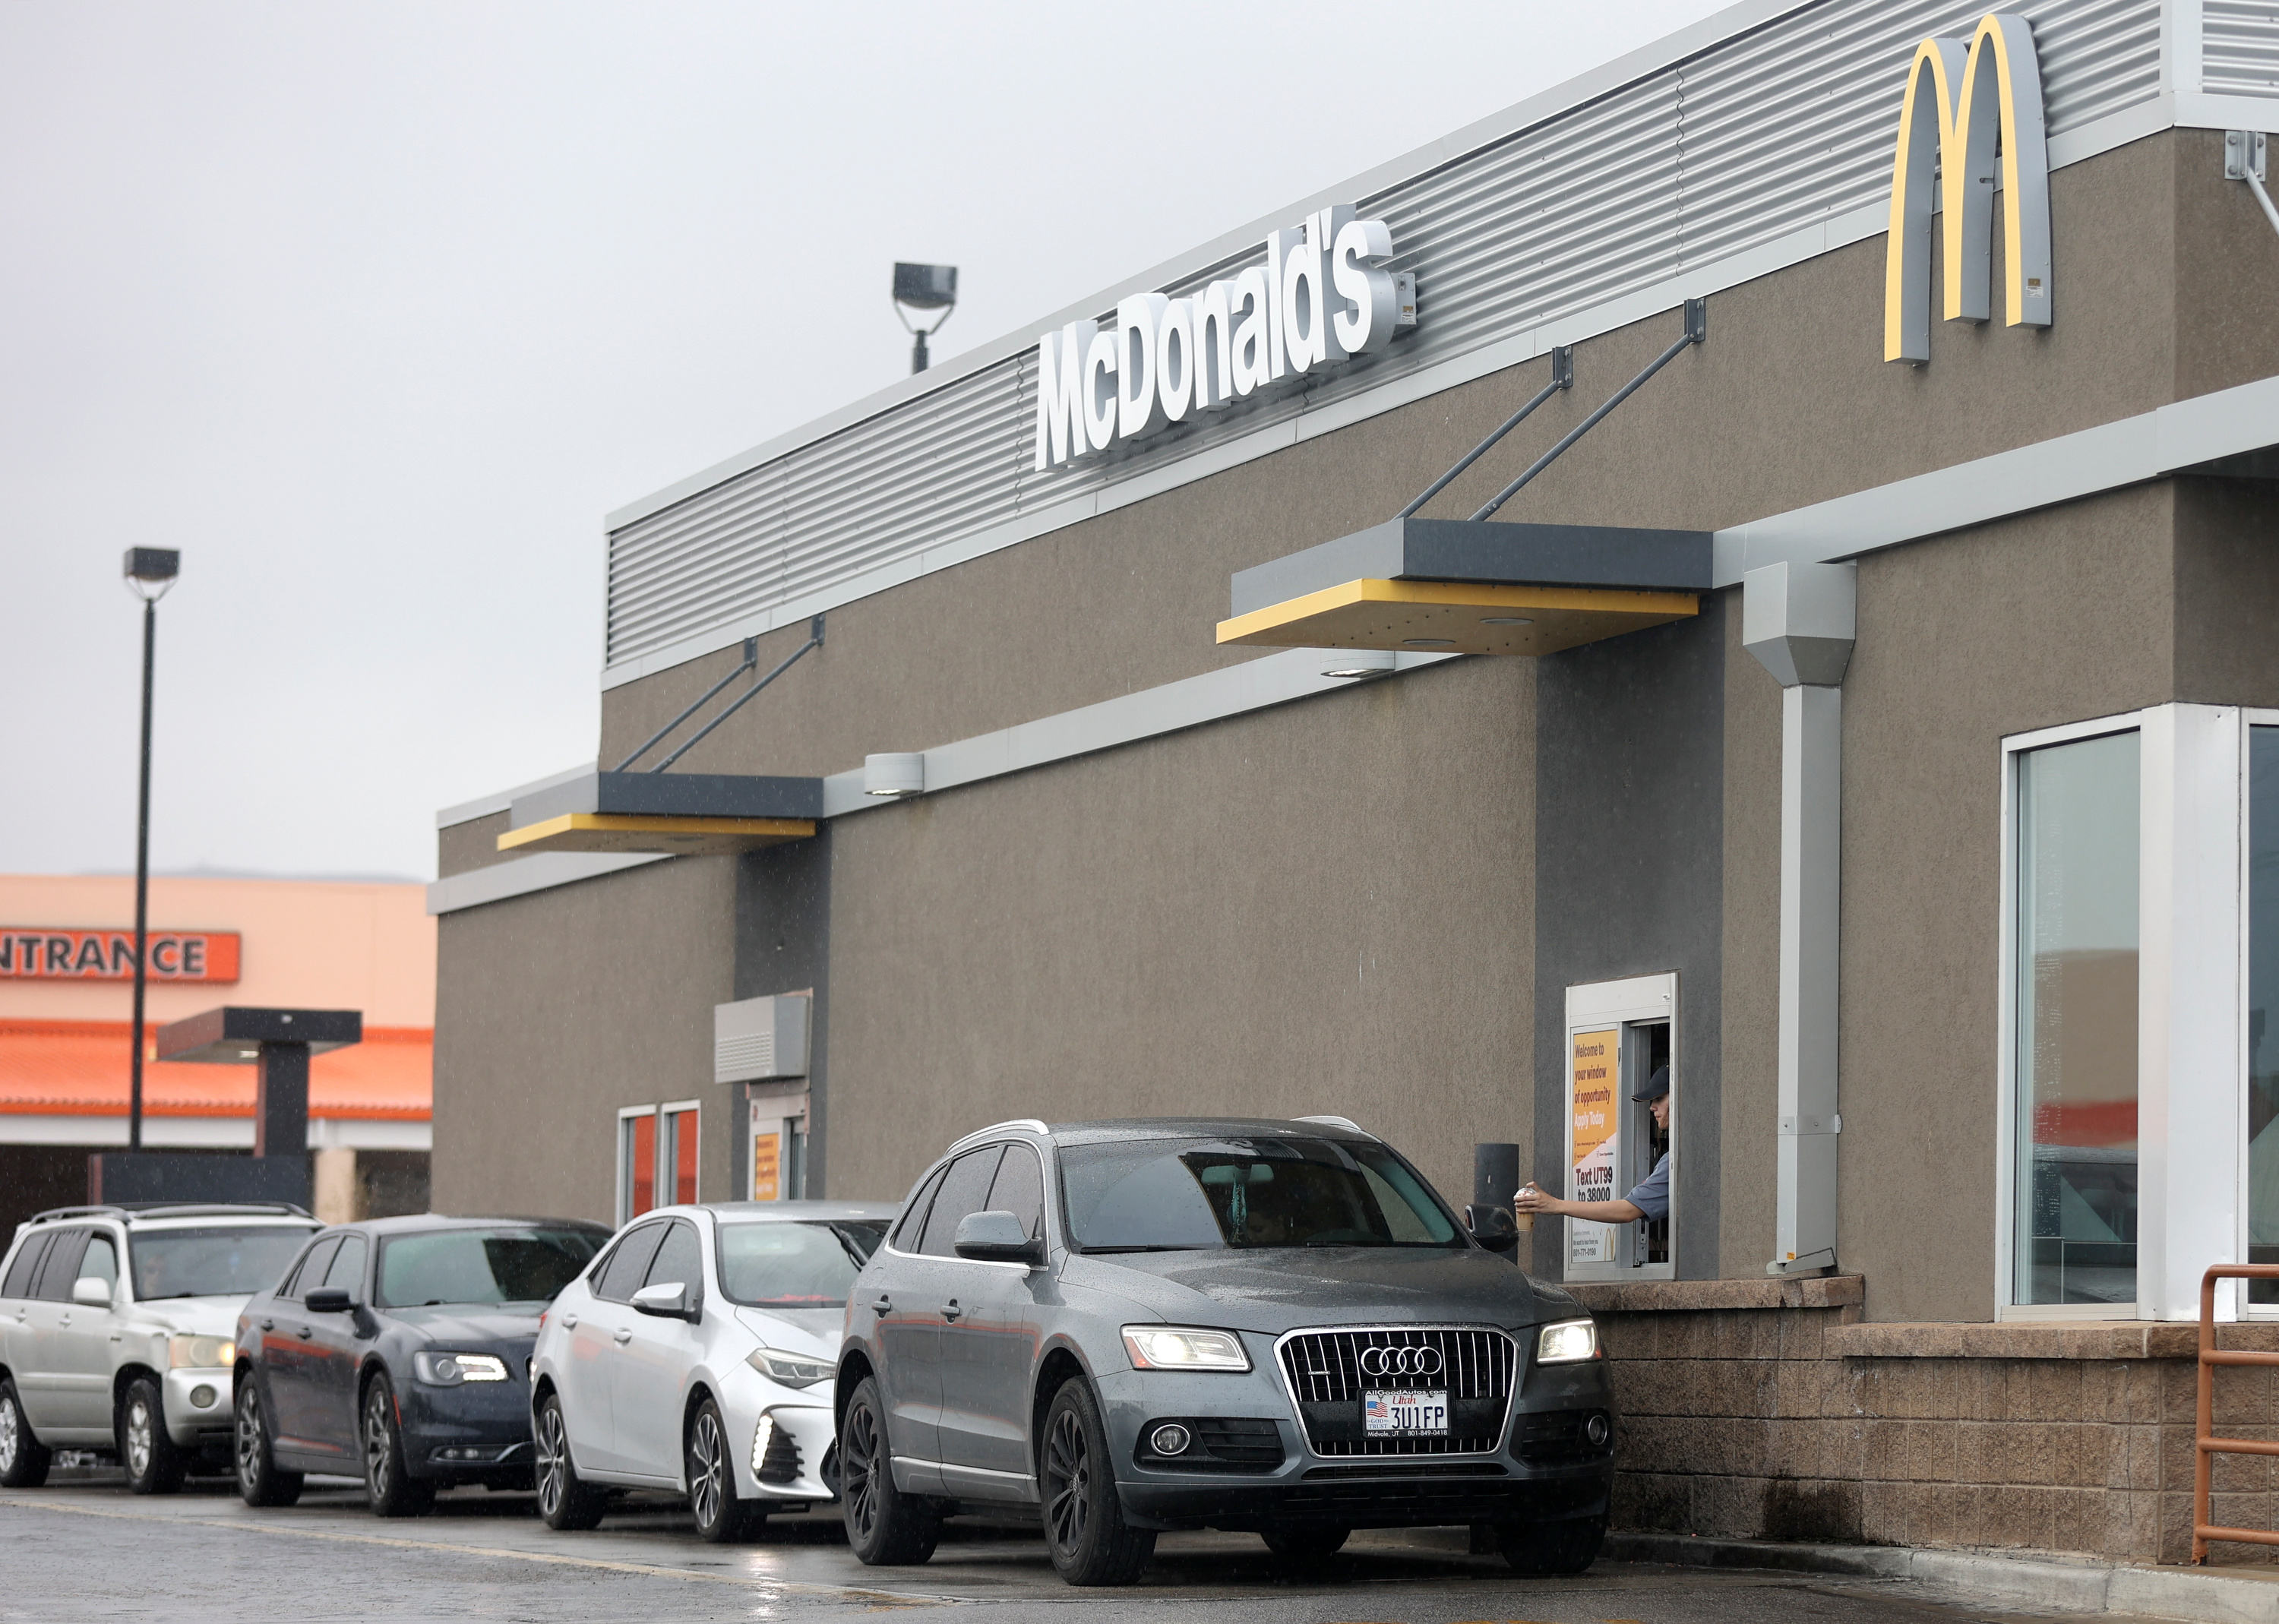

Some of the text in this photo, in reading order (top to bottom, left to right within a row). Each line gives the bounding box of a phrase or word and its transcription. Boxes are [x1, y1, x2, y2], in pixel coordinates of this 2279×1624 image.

[1035, 205, 1377, 472] McDonald's
[1575, 1043, 1604, 1058] Welcome to
[1574, 1064, 1607, 1085] your window
[1574, 1085, 1610, 1107] of opportunity
[1574, 1110, 1604, 1130] Apply Today
[1576, 1166, 1613, 1186] Text UT99
[1578, 1186, 1610, 1202] to 38000
[1392, 1394, 1417, 1404] Utah
[1391, 1406, 1444, 1429] 3U1FP
